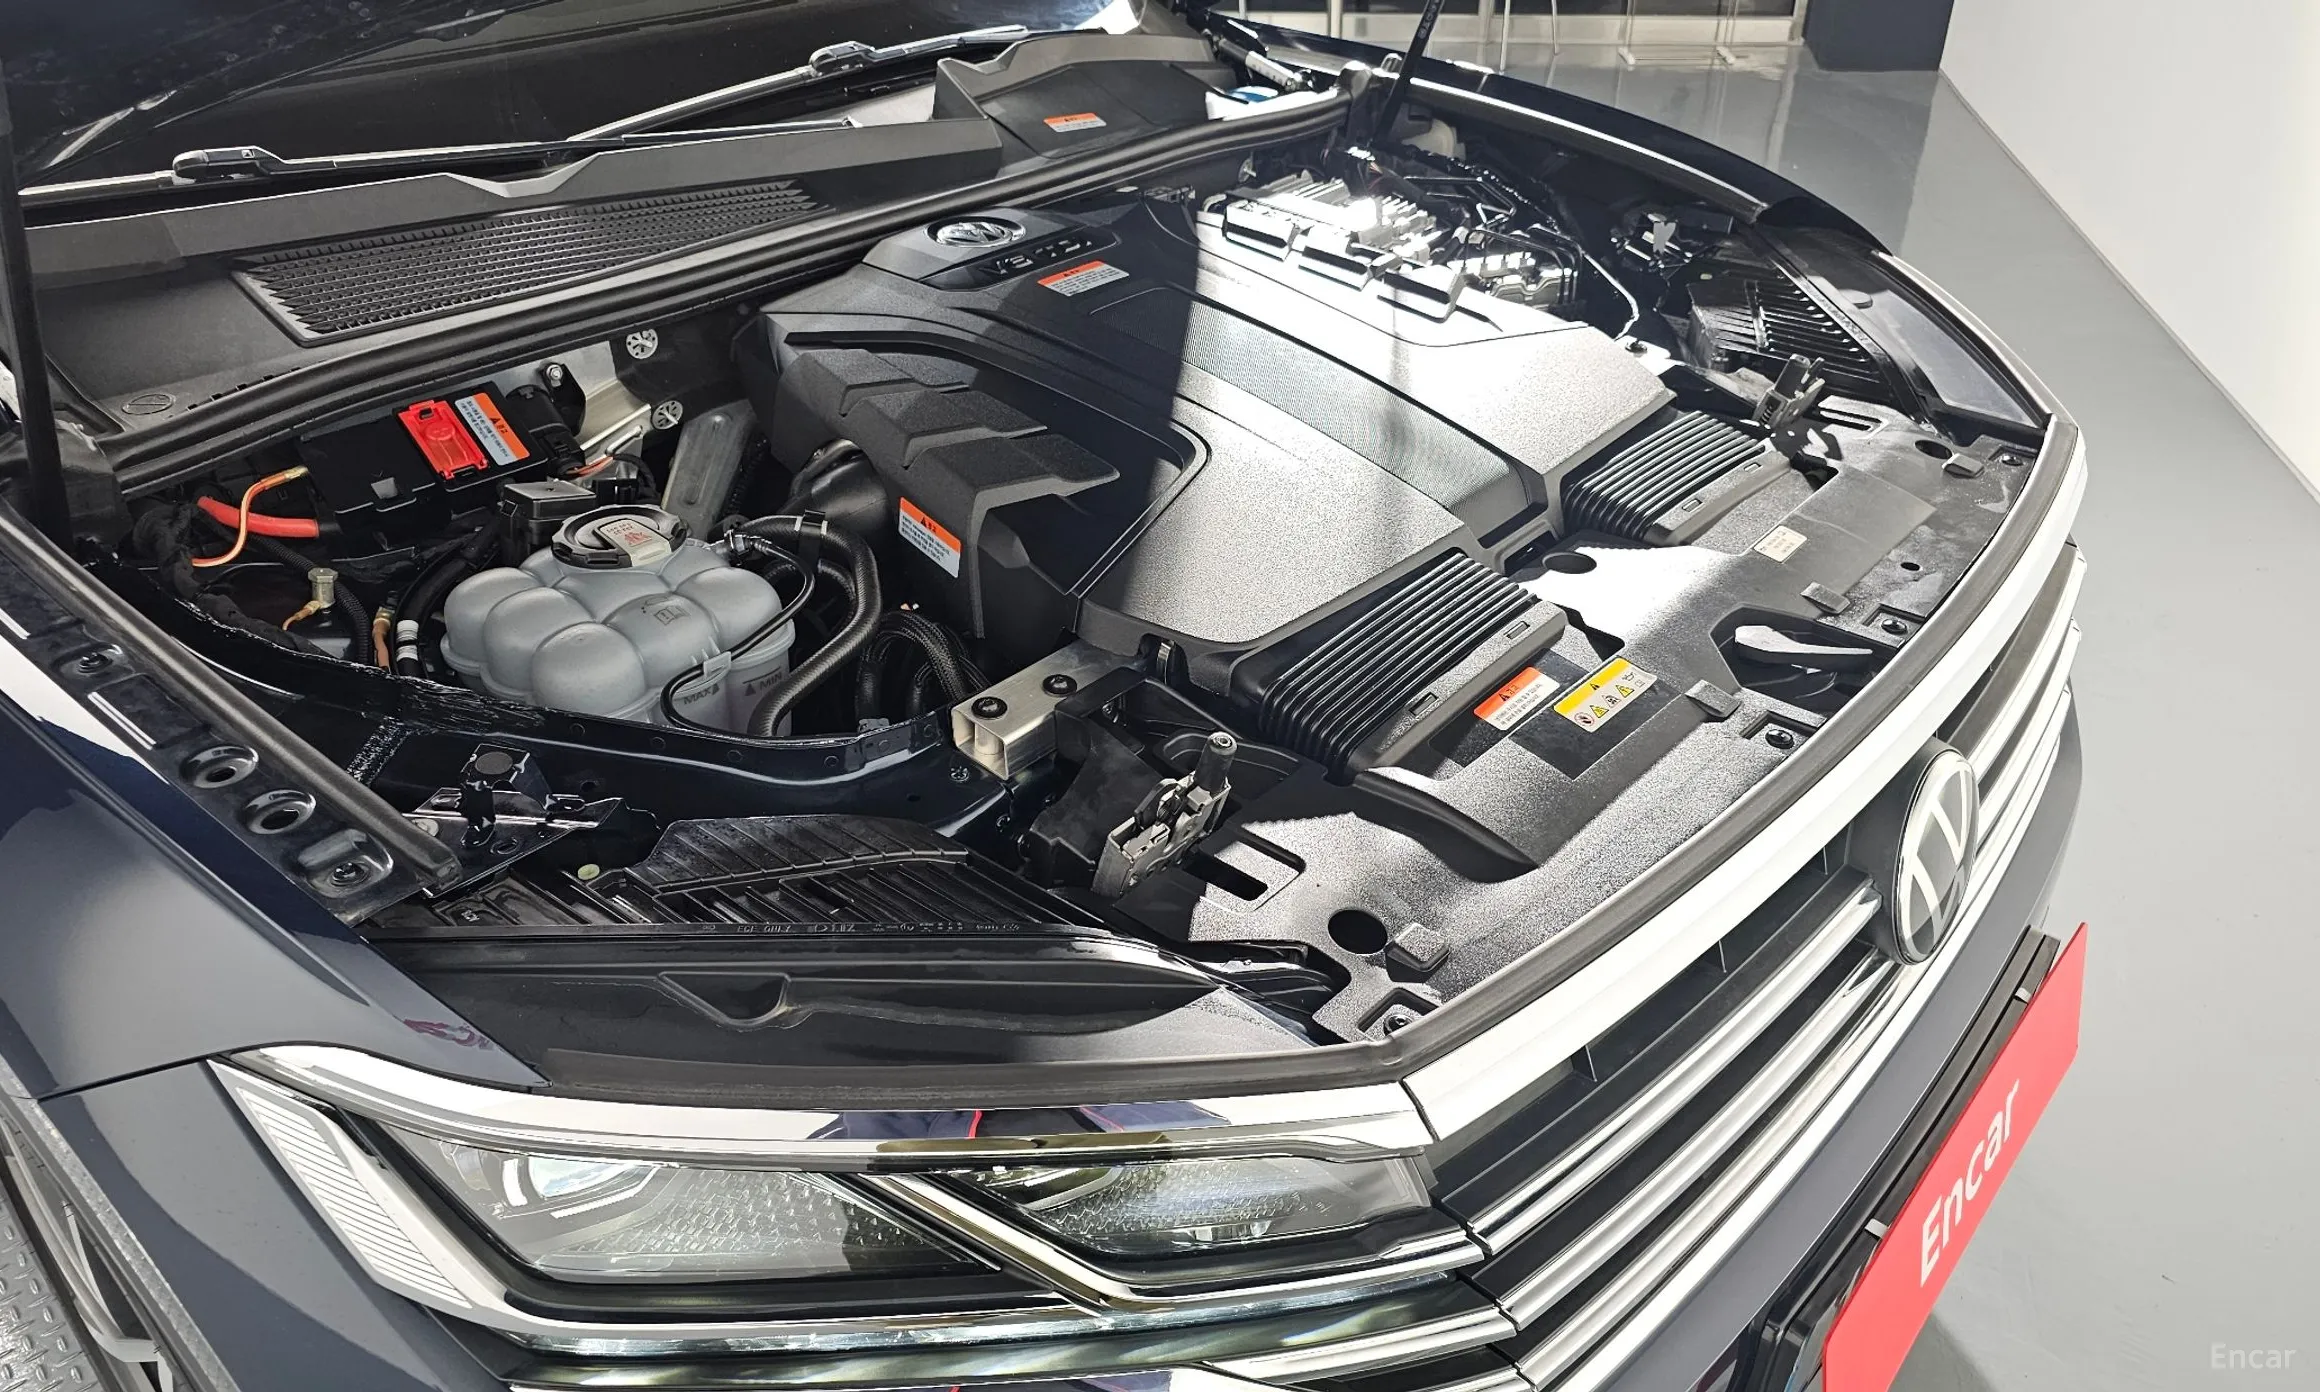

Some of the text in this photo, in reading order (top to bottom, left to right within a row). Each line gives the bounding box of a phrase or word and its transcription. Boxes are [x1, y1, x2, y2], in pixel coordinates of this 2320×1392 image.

[759, 672, 782, 690] MIN
[683, 687, 713, 705] MAX
[1920, 1078, 2020, 1288] Encar
